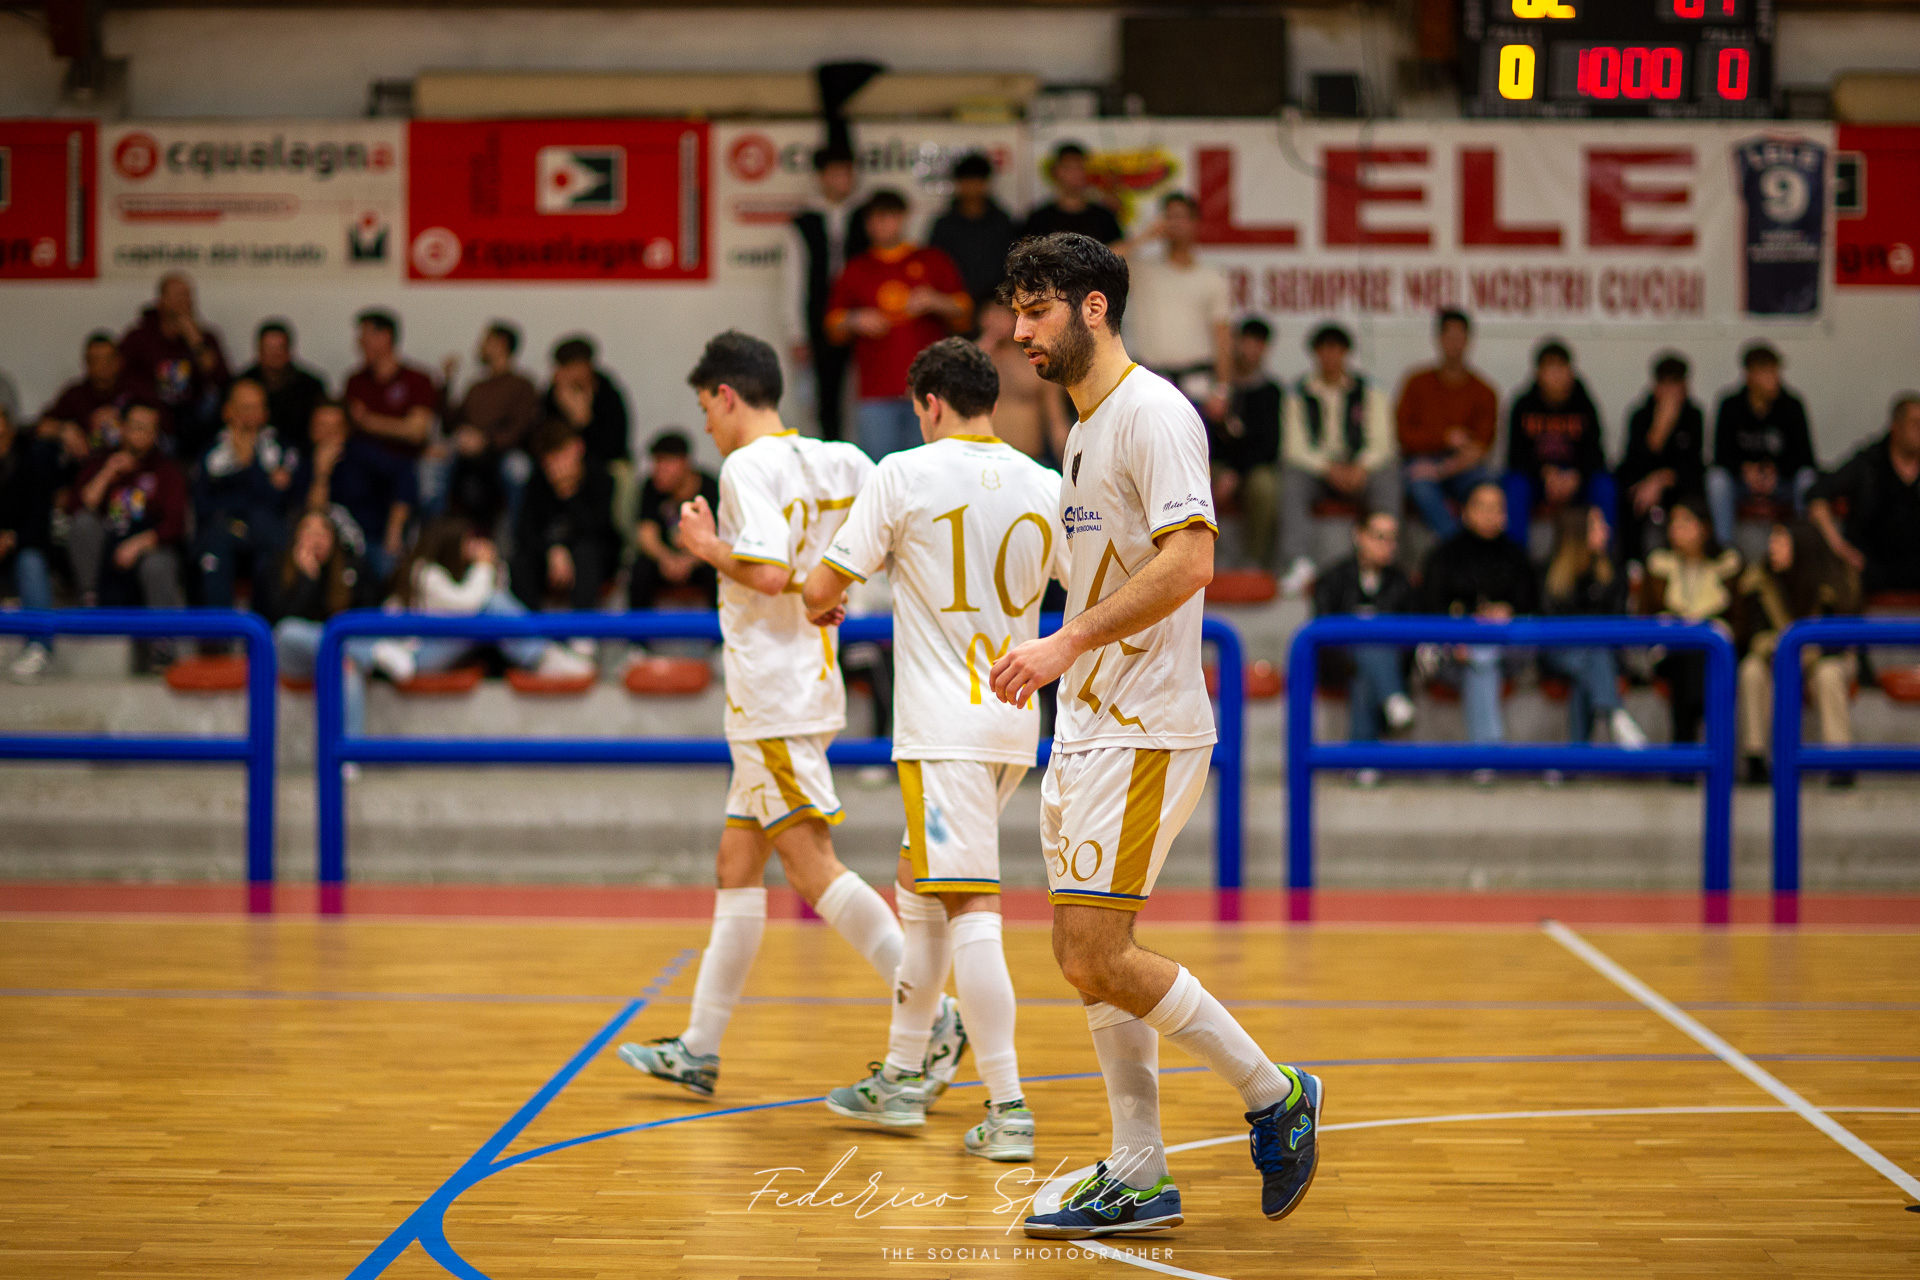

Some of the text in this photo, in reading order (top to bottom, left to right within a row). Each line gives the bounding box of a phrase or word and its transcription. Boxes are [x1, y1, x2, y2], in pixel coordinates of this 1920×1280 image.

[1499, 45, 1535, 99] 0
[1717, 48, 1750, 100] 0
[1193, 146, 1698, 248] LELE
[1759, 164, 1812, 225] 9
[932, 504, 1052, 618] 10
